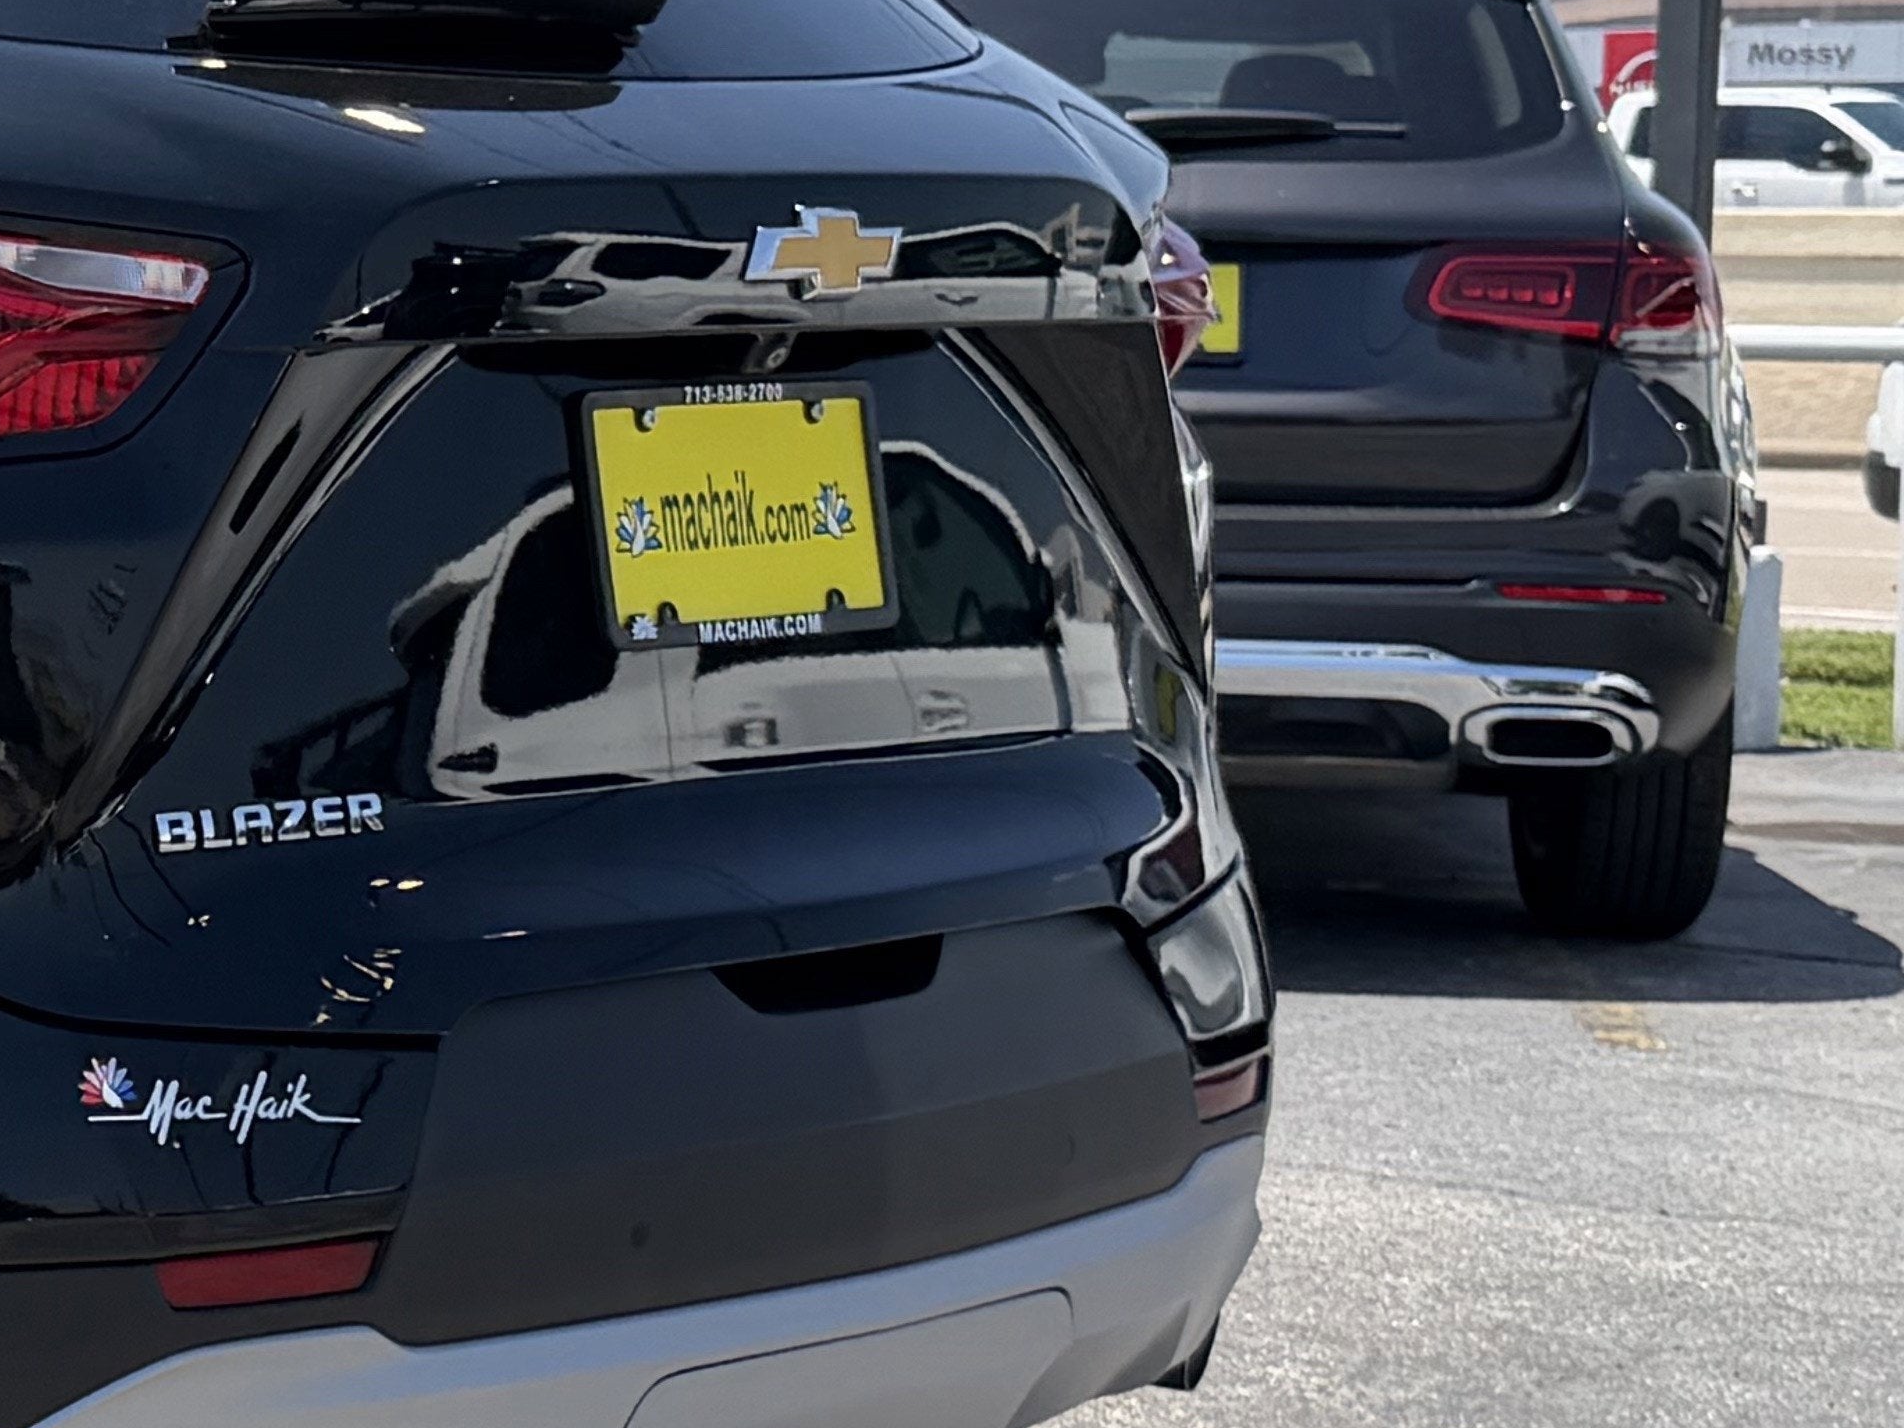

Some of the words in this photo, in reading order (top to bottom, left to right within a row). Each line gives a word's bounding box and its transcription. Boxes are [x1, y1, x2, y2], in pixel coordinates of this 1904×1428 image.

[1747, 42, 1856, 72] Mossy
[660, 470, 810, 552] machaik.com
[699, 613, 822, 644] MACHAIK.COM
[155, 792, 384, 853] BLAZER
[88, 1079, 227, 1146] Mac
[229, 1070, 362, 1145] Haik
